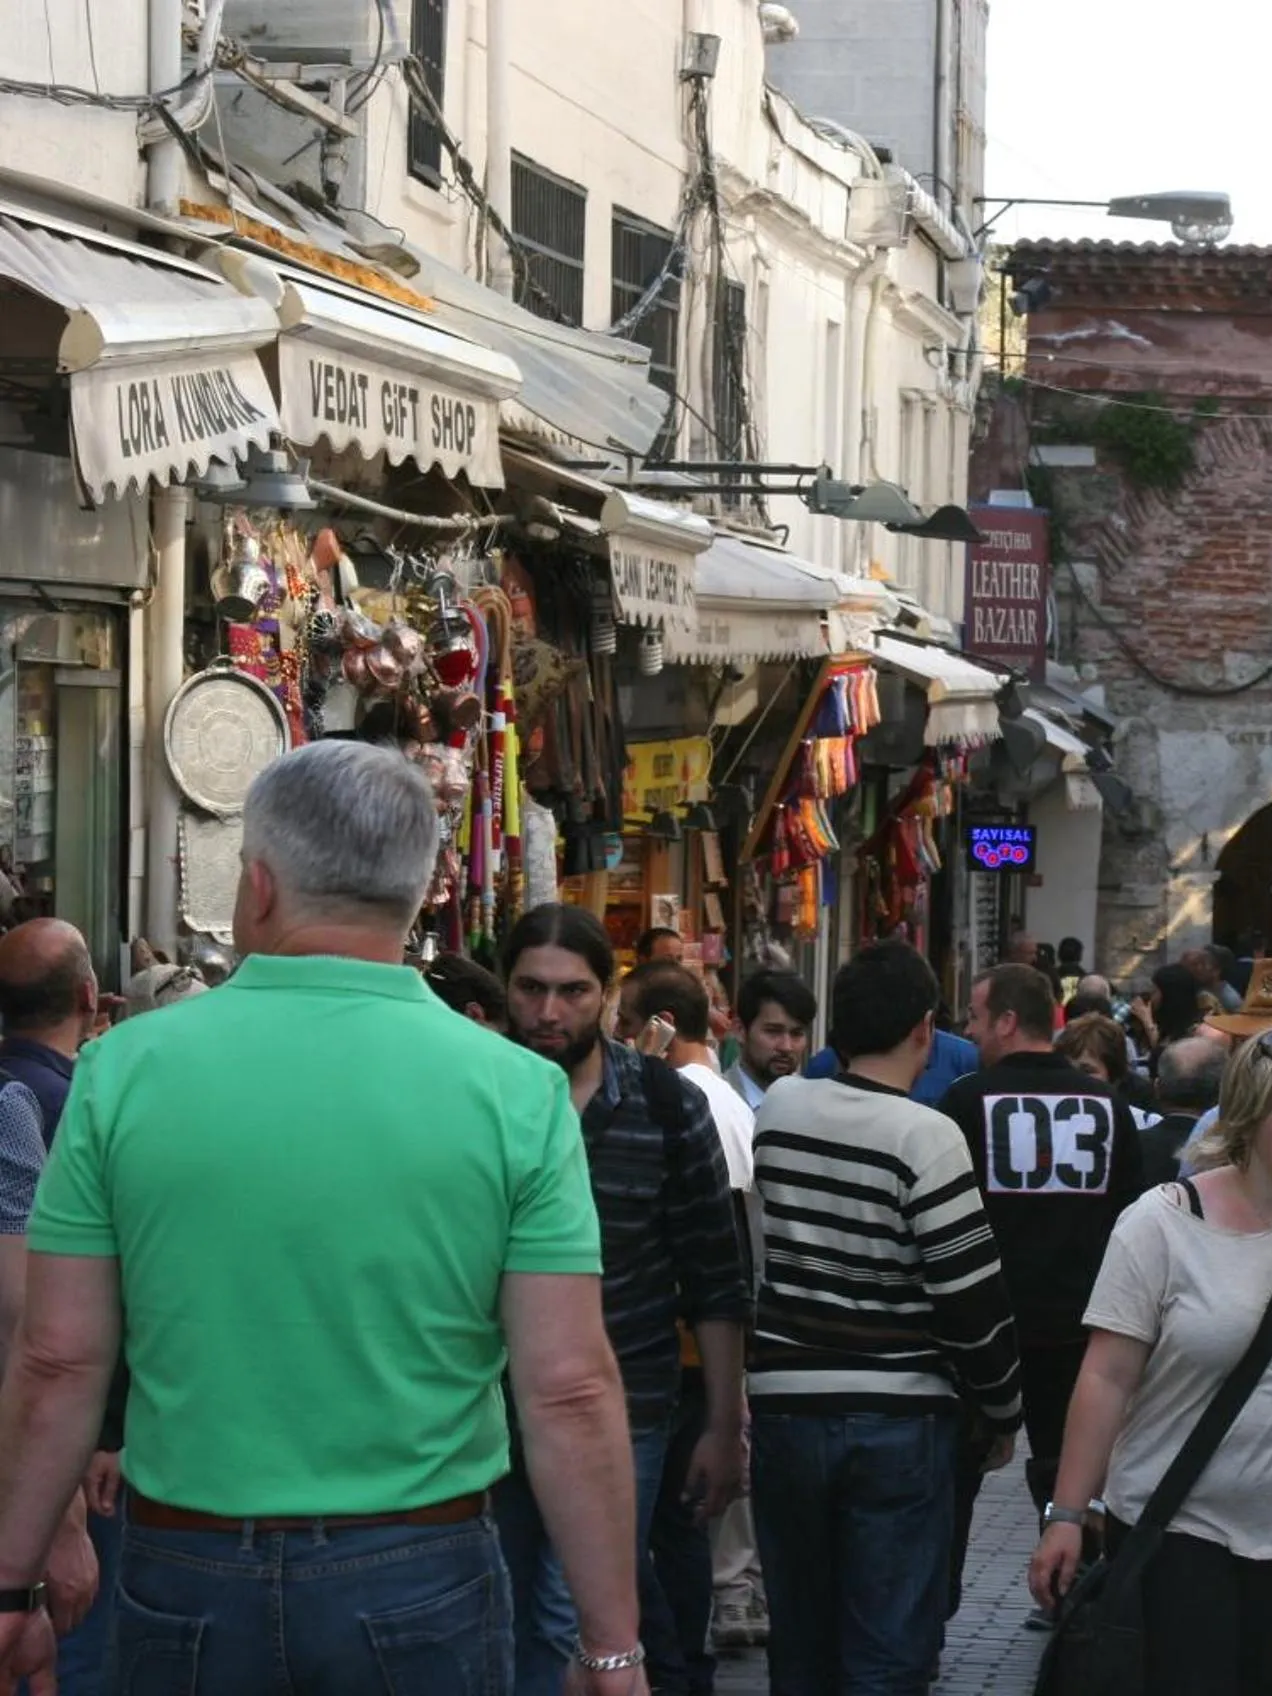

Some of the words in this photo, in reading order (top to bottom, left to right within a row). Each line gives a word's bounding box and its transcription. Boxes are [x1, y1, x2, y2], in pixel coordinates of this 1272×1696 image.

[116, 379, 170, 458] LORA
[171, 368, 267, 443] KUNDURA
[309, 359, 369, 430] VEDAT
[431, 393, 476, 456] SHOP
[972, 561, 1040, 600] LEATHER
[974, 606, 1037, 645] BAZAAR
[972, 828, 1031, 841] SAYISAL
[991, 1096, 1111, 1190] 03
